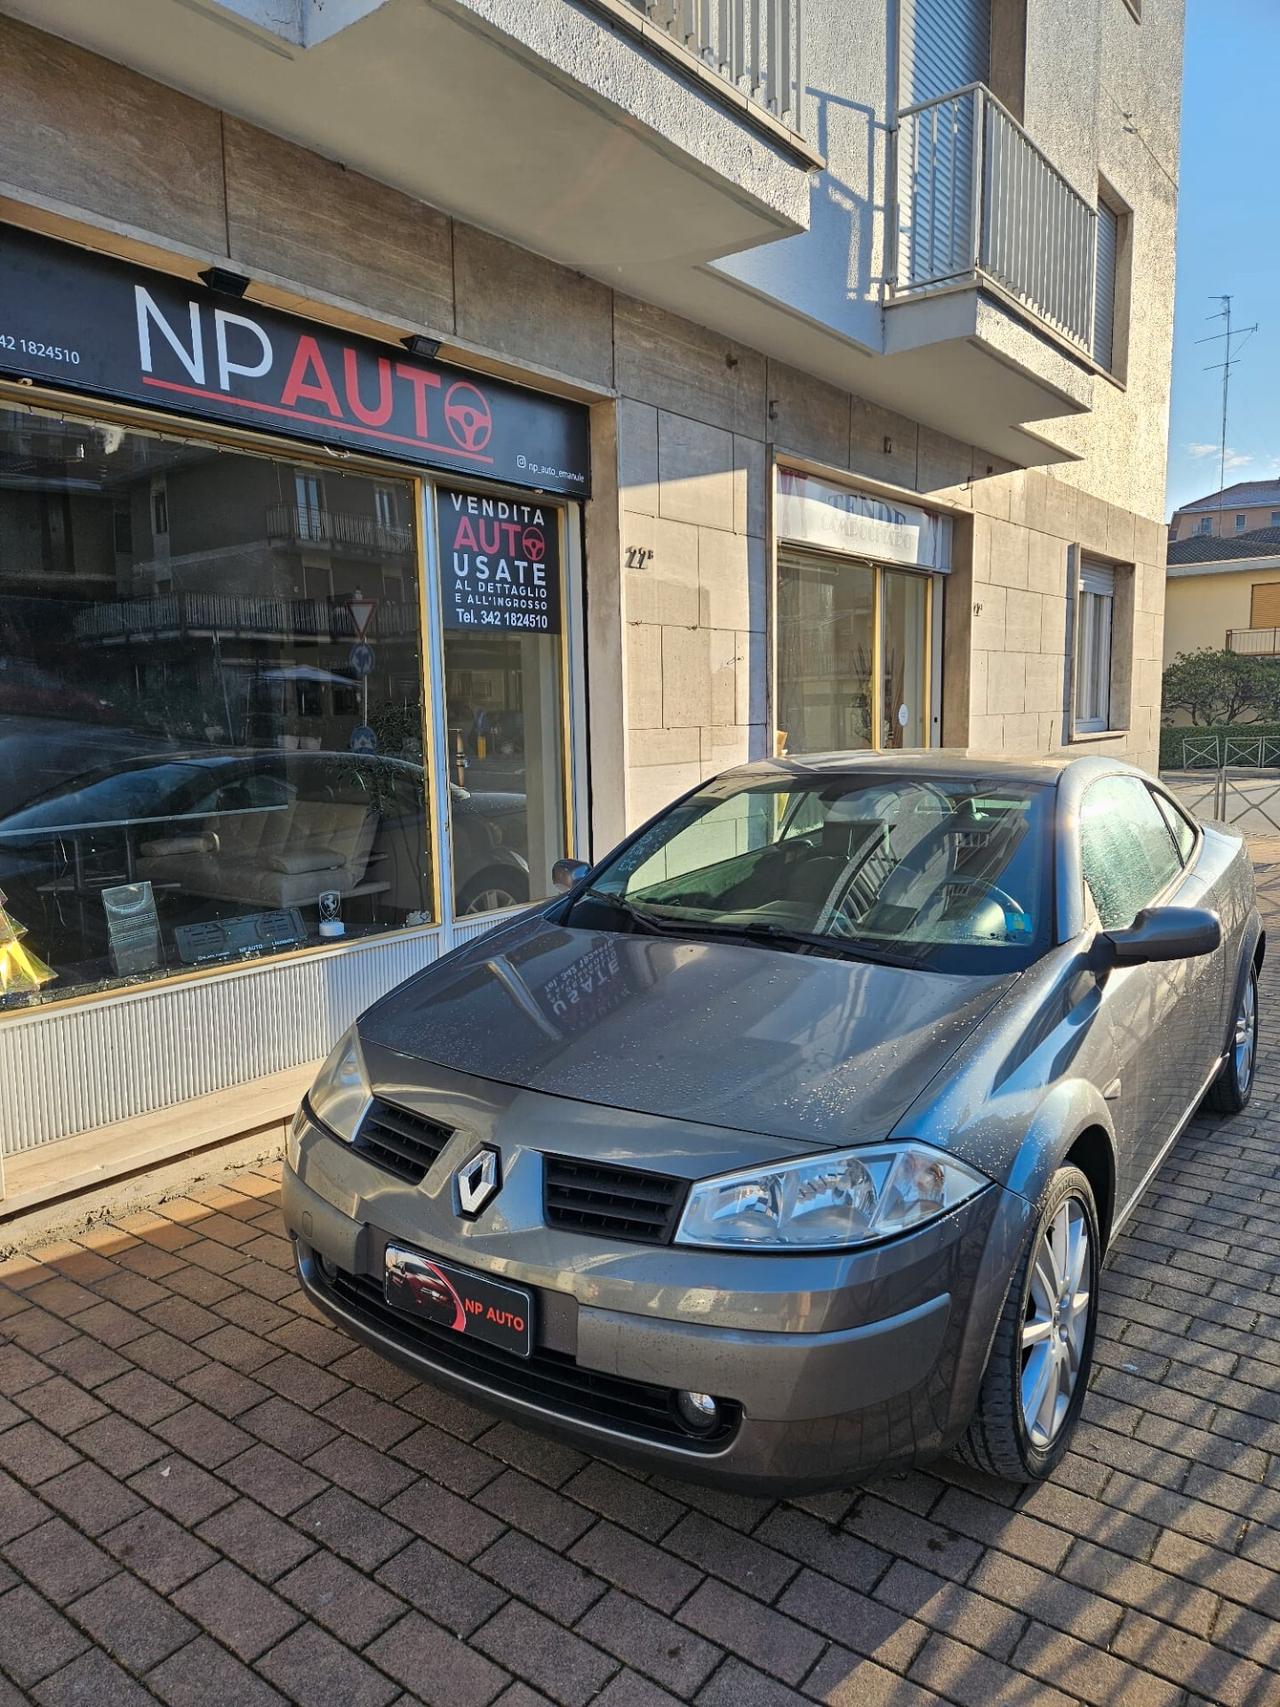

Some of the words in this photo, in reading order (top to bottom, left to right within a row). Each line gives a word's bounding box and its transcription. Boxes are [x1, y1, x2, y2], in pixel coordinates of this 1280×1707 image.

[20, 339, 80, 365] 1824510
[134, 284, 273, 391] NP
[451, 493, 545, 526] VENDITA
[453, 552, 546, 586] USATE
[455, 579, 472, 591] AL
[478, 581, 547, 599] DETTAGLIO
[455, 593, 462, 603] E
[467, 594, 548, 611] ALL'INGROSSO
[456, 608, 478, 624] Tel.
[481, 610, 501, 625] 342
[504, 611, 548, 629] 1824510
[465, 1298, 483, 1315] NP
[486, 1306, 525, 1332] AUTO
